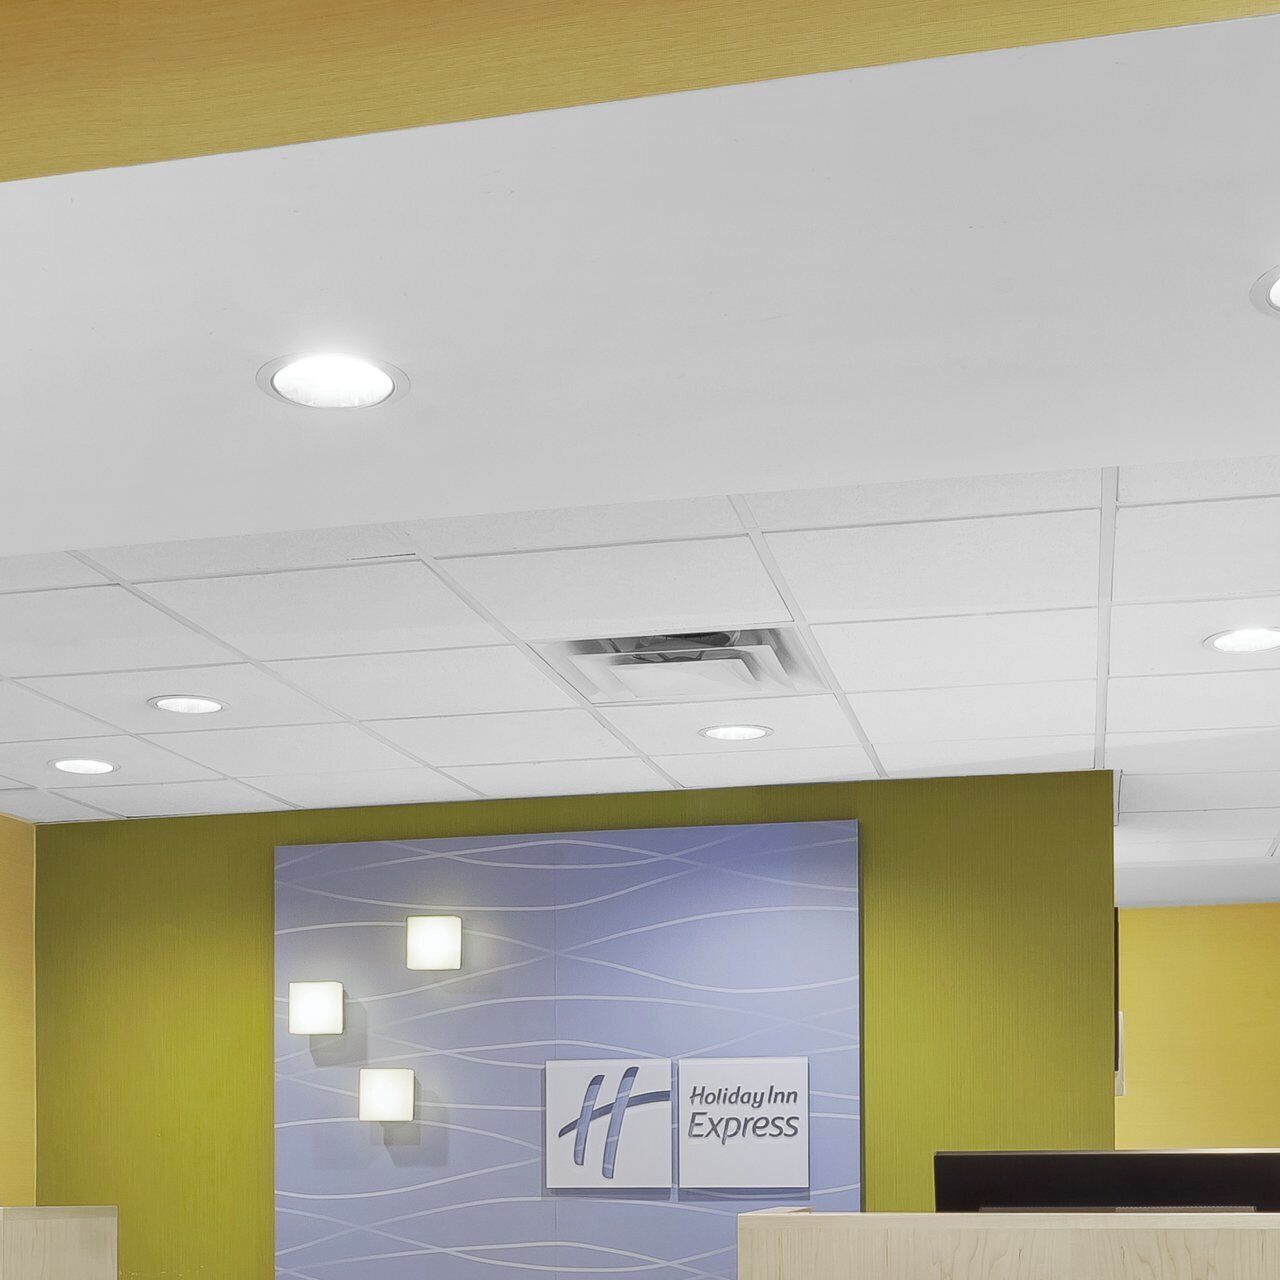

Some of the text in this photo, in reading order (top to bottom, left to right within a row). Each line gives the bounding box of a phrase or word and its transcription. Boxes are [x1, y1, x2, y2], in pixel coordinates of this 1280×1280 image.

[689, 1084, 798, 1109] Holiday Inn
[687, 1111, 800, 1146] Express
